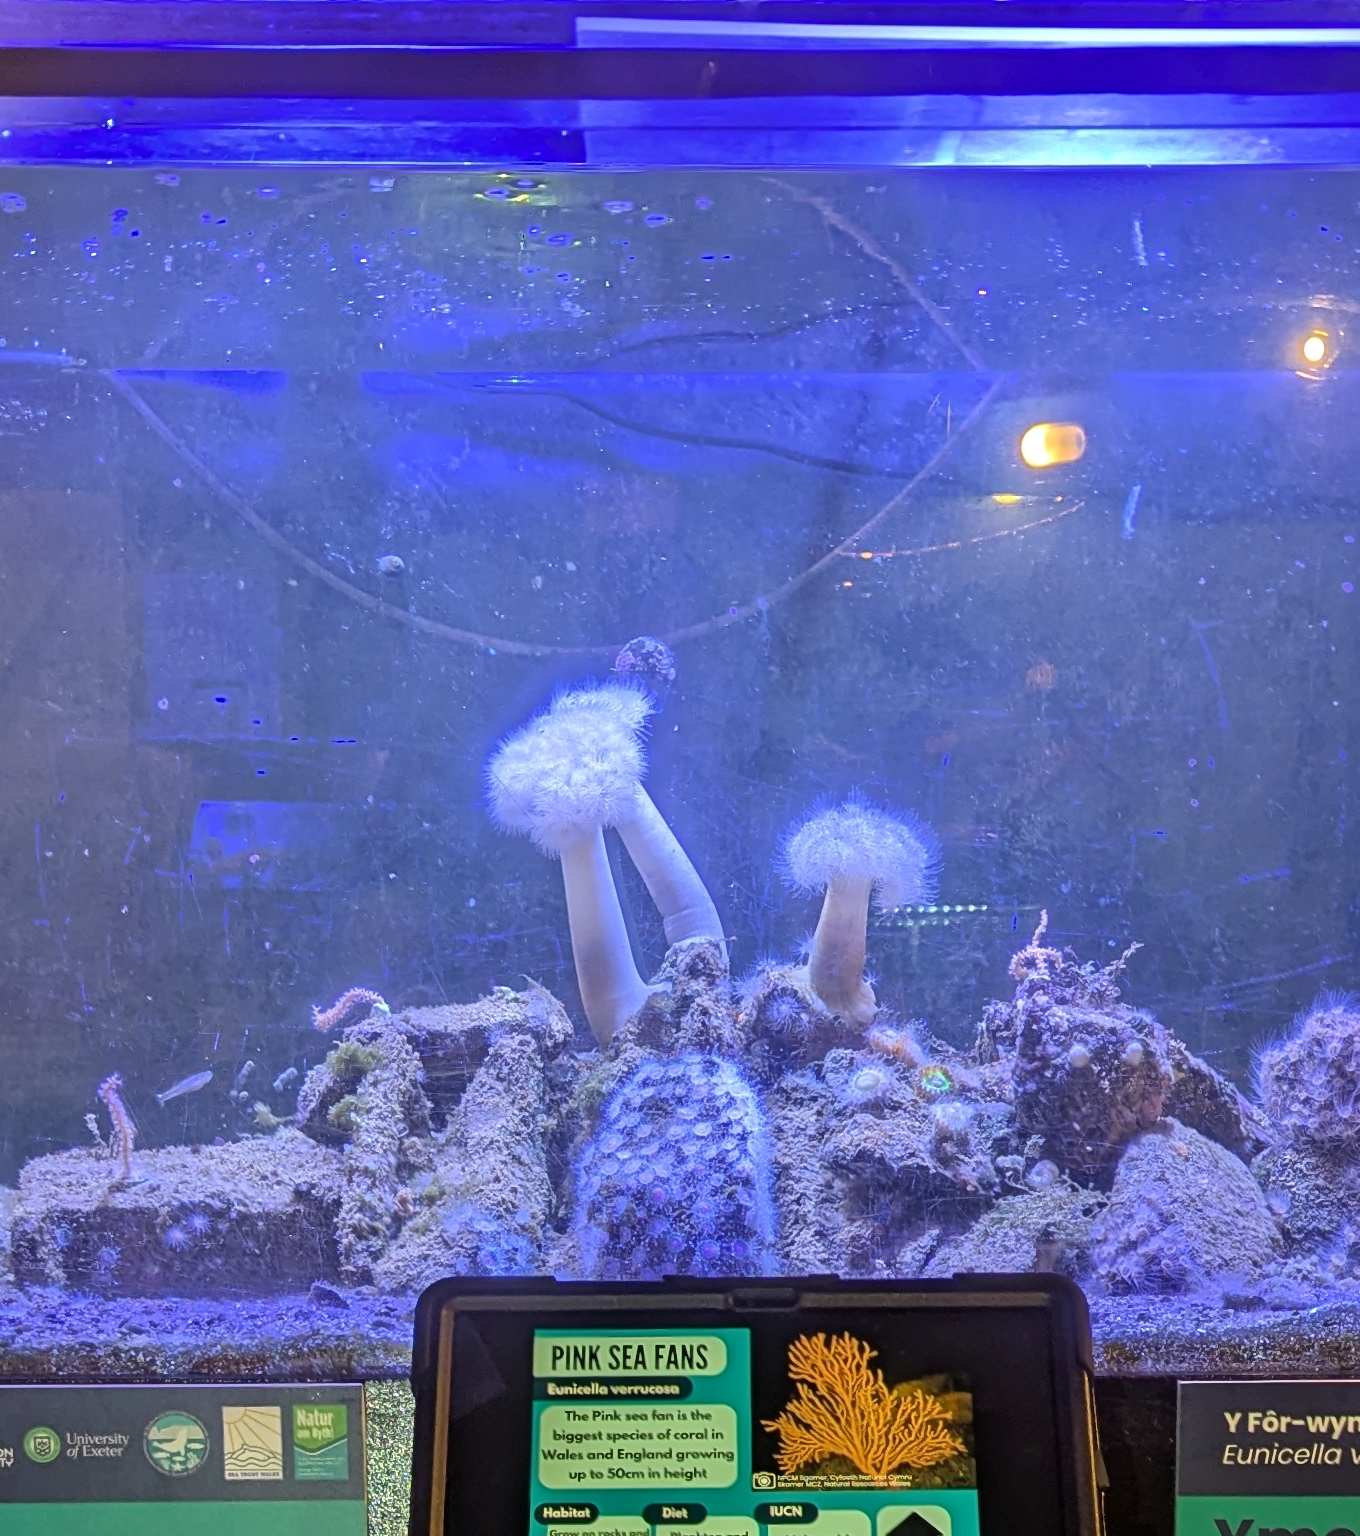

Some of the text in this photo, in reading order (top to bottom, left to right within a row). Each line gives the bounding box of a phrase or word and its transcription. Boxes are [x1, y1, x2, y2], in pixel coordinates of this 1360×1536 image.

[552, 1344, 707, 1370] PINK SEA FANS
[547, 1383, 680, 1396] Eunicella verrucosa
[564, 1410, 589, 1421] The
[592, 1410, 621, 1421] Pink
[651, 1409, 673, 1420] fan
[677, 1409, 687, 1420] is
[690, 1409, 712, 1420] the
[1223, 1412, 1242, 1432] Y
[552, 1428, 724, 1443] biggest species of coral in
[541, 1448, 734, 1462] Wales and England growing
[1222, 1442, 1342, 1464] Eunicella
[568, 1466, 707, 1482] up to 50cm in height
[542, 1507, 591, 1519] Habitat
[661, 1507, 688, 1519] Diet
[769, 1505, 803, 1517] IUCN
[598, 1528, 626, 1536] rocks
[629, 1528, 649, 1536] and
